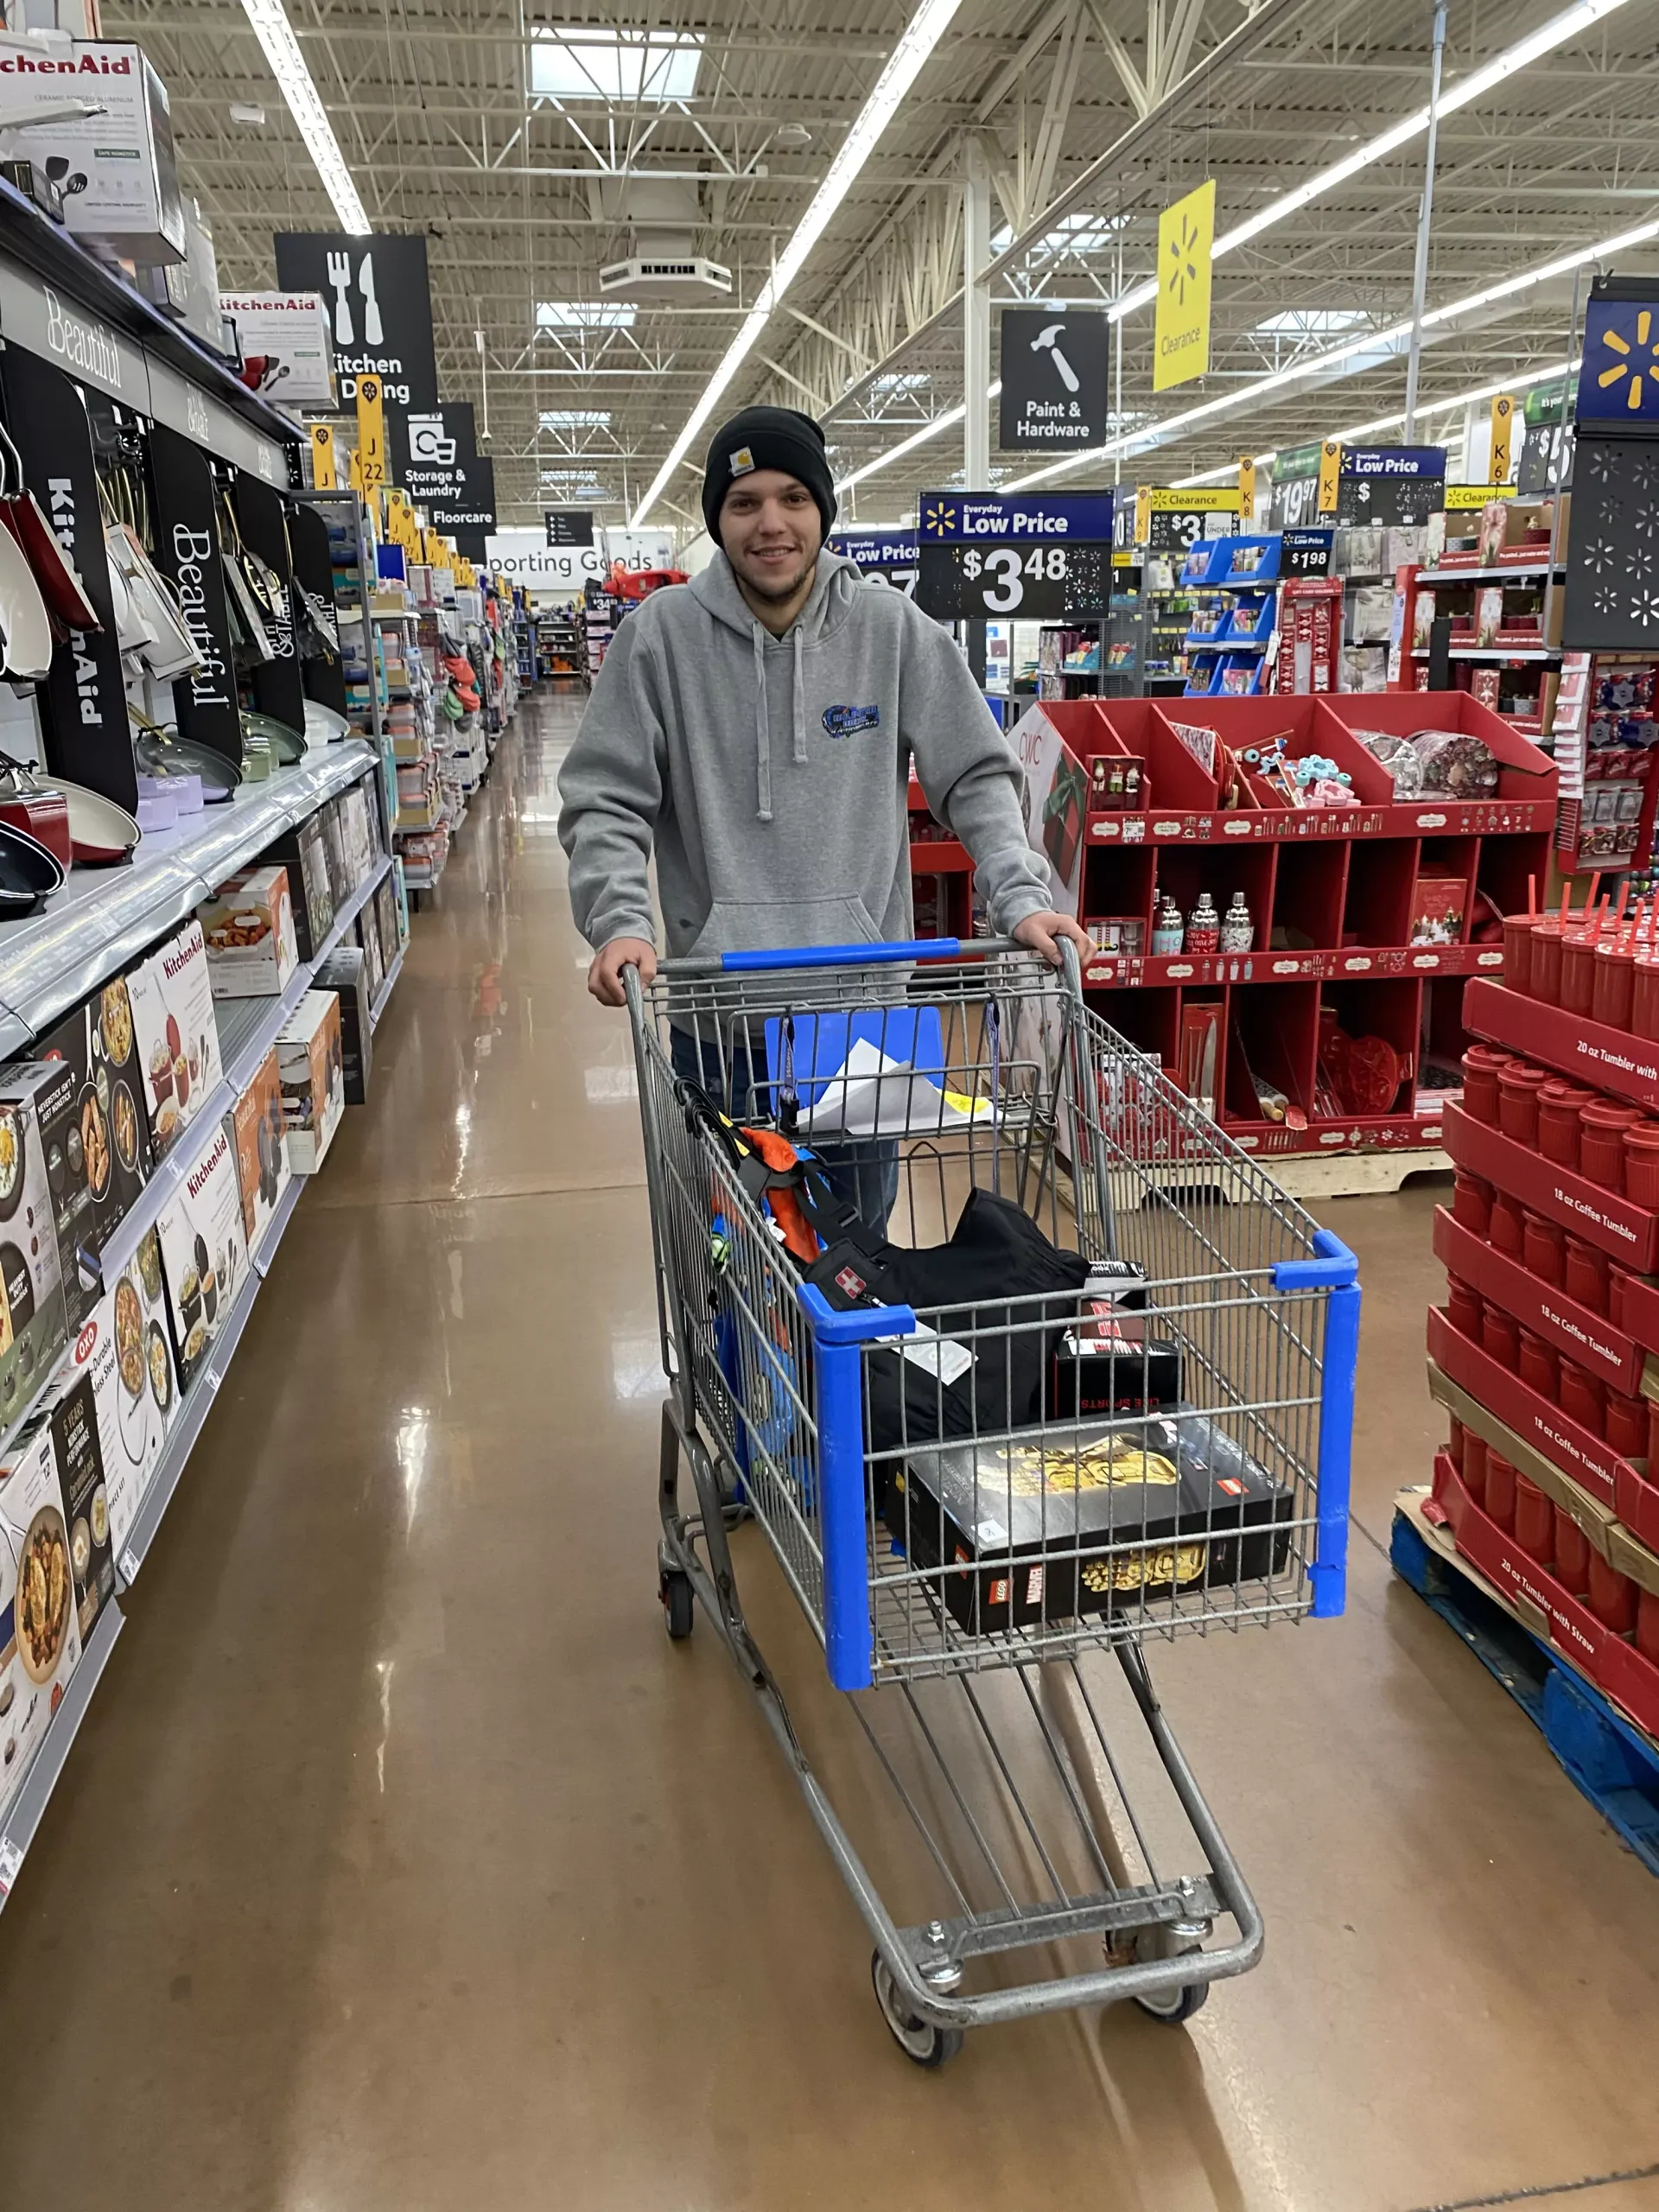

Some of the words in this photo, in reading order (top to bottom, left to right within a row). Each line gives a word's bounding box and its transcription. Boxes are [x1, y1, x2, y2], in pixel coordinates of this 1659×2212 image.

[43, 285, 121, 388] Beautiful
[1161, 326, 1201, 356] Clearance
[1026, 401, 1065, 417] Paint
[1069, 401, 1081, 417] &
[1016, 420, 1090, 437] Hardware
[368, 439, 376, 456] J
[1495, 444, 1505, 459] K
[364, 463, 383, 480] 22
[1355, 460, 1383, 474] Low
[1385, 459, 1419, 473] Price
[1495, 465, 1502, 478] 6
[405, 469, 453, 484] Storage
[456, 469, 466, 481] &
[412, 484, 461, 499] Laundry
[1324, 480, 1333, 492] K
[1170, 495, 1217, 505] Clearance
[1243, 493, 1251, 503] K
[1325, 497, 1332, 507] 7
[434, 511, 493, 524] Floorcare
[963, 504, 1002, 515] Everyday
[1243, 506, 1250, 516] 8
[963, 514, 1009, 534] Low
[1013, 512, 1069, 533] Price
[847, 540, 874, 549] Everyday
[847, 546, 880, 563] Low
[882, 545, 919, 559] Price
[162, 933, 203, 980] KitchenAid
[1577, 1039, 1587, 1054] 20
[1588, 1047, 1599, 1058] oz
[1599, 1048, 1636, 1072] Tumbler
[1637, 1063, 1657, 1080] with
[38, 1087, 62, 1116] NEVERSTICK
[42, 1106, 52, 1123] JUST
[52, 1091, 72, 1116] NONSTICK
[187, 1134, 228, 1199] KitchenAid
[1554, 1187, 1564, 1201] 18
[1564, 1194, 1574, 1207] oz
[1574, 1199, 1601, 1223] Coffee
[1602, 1214, 1637, 1243] Tumbler
[79, 1327, 94, 1359] OXO
[1541, 1304, 1550, 1318] 18
[1551, 1313, 1560, 1324] oz
[1561, 1319, 1587, 1344] Coffee
[1588, 1336, 1623, 1366] Tumbler
[104, 1351, 116, 1380] Steel
[1135, 1396, 1160, 1408] LIE
[68, 1398, 85, 1431] YEARS
[1534, 1416, 1542, 1430] 18
[1543, 1424, 1553, 1437] oz
[1554, 1433, 1580, 1460] Coffee
[1581, 1454, 1614, 1486] Tumbler
[996, 1580, 1007, 1602] LEGO
[1501, 1558, 1511, 1573] 20
[1511, 1569, 1522, 1583] oz
[1522, 1577, 1552, 1611] Tumbler
[1553, 1605, 1571, 1631] with
[1572, 1624, 1594, 1654] Straw
